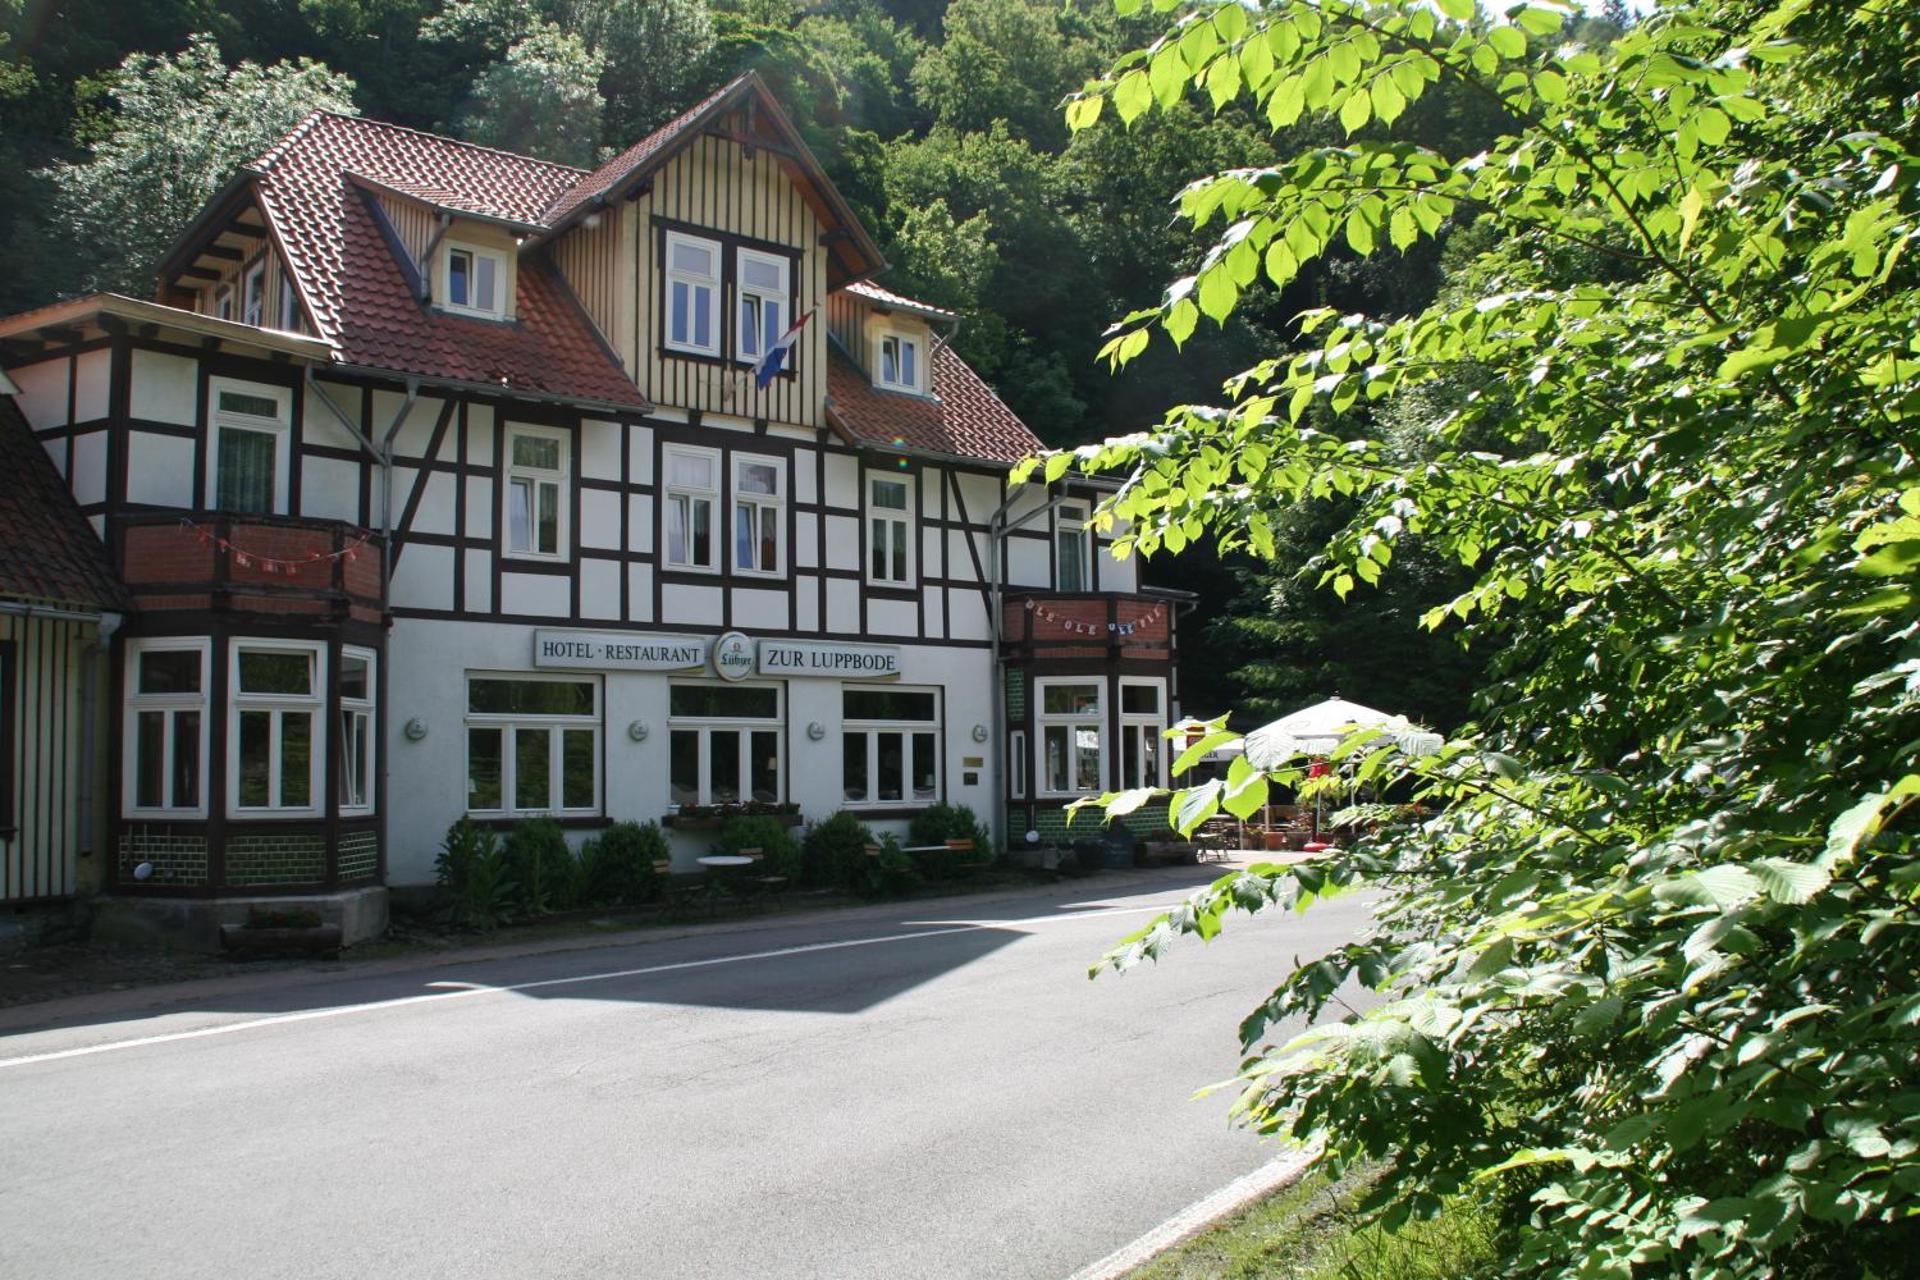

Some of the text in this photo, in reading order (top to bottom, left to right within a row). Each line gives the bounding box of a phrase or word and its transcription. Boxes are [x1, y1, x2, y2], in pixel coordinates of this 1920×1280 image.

[1064, 620, 1097, 636] OLE
[543, 641, 700, 663] HOTEL RESTAURANT
[767, 649, 896, 672] ZUR LUPPBODE
